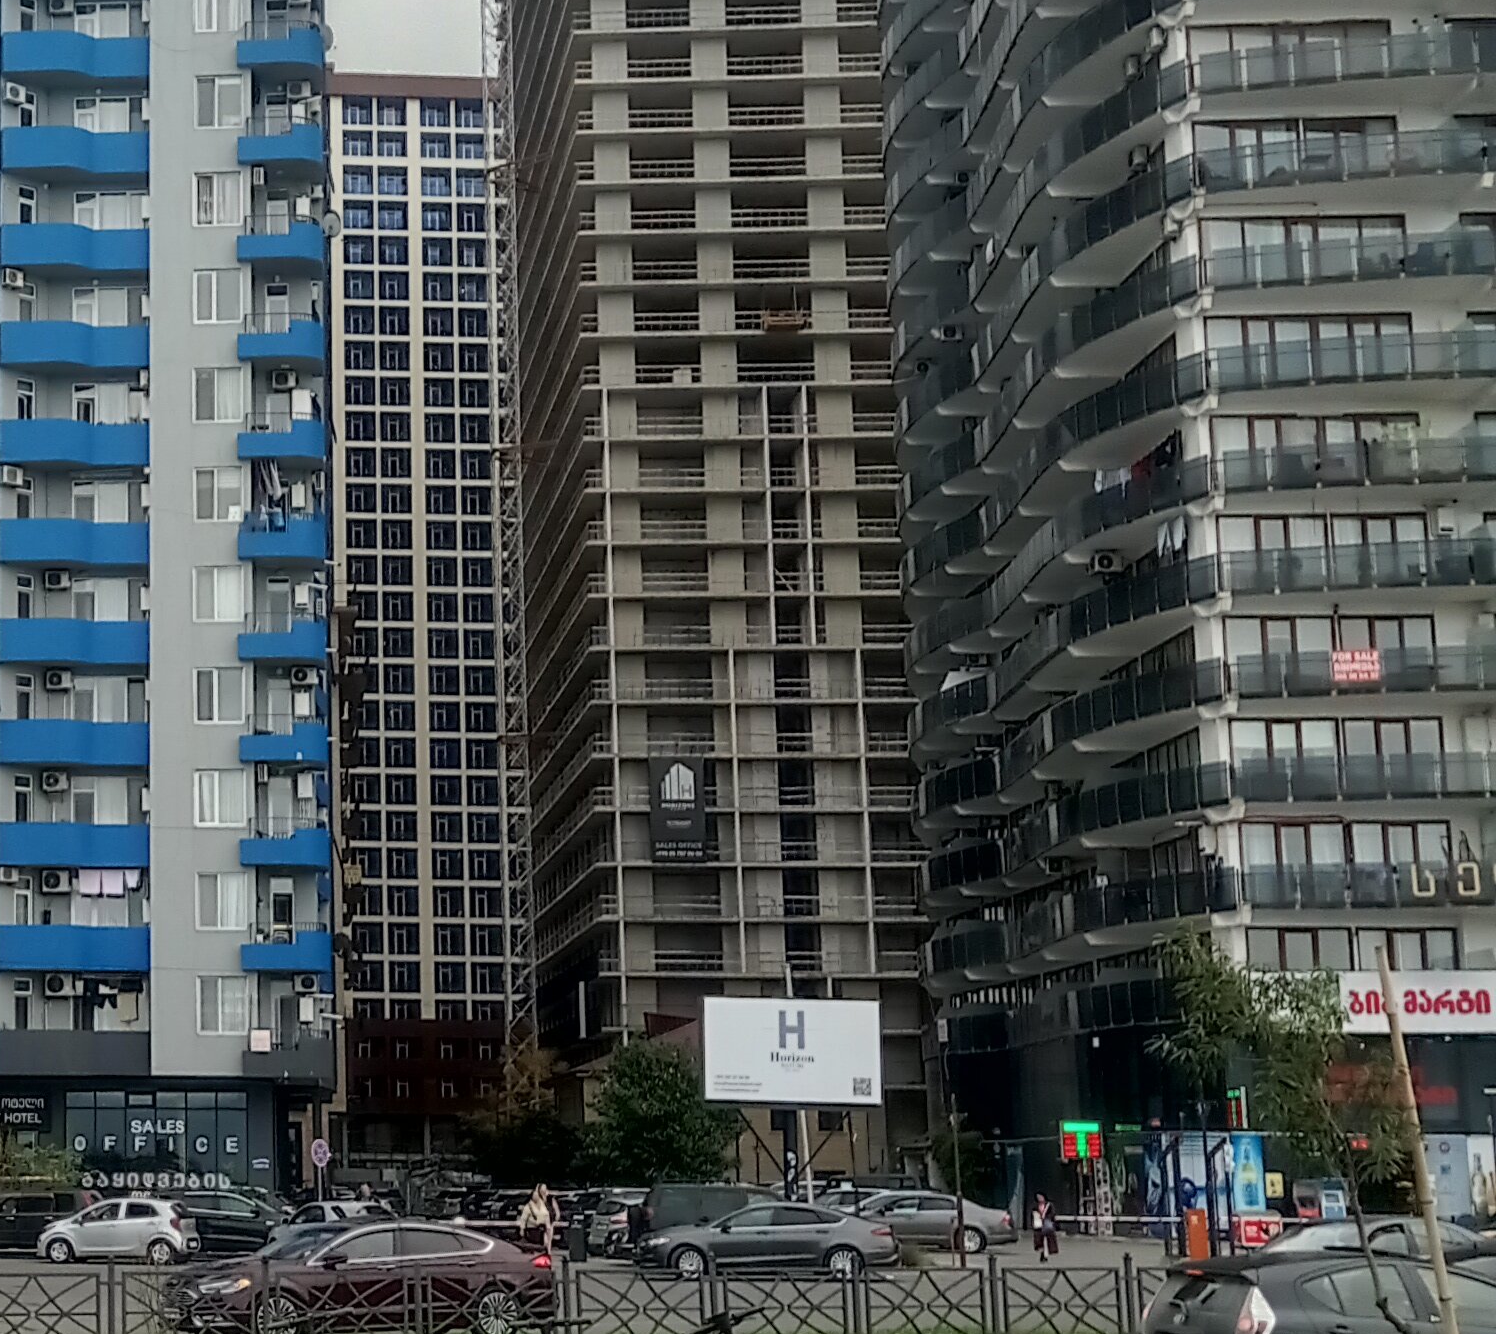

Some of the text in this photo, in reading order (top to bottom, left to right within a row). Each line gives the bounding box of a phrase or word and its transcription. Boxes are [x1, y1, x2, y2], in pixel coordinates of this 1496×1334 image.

[1332, 650, 1379, 663] FOR SALE
[778, 1009, 805, 1049] H
[770, 1051, 815, 1063] Horizon
[3, 1112, 43, 1124] HOTEL
[130, 1119, 186, 1135] SALES
[73, 1135, 240, 1154] OFFICE
